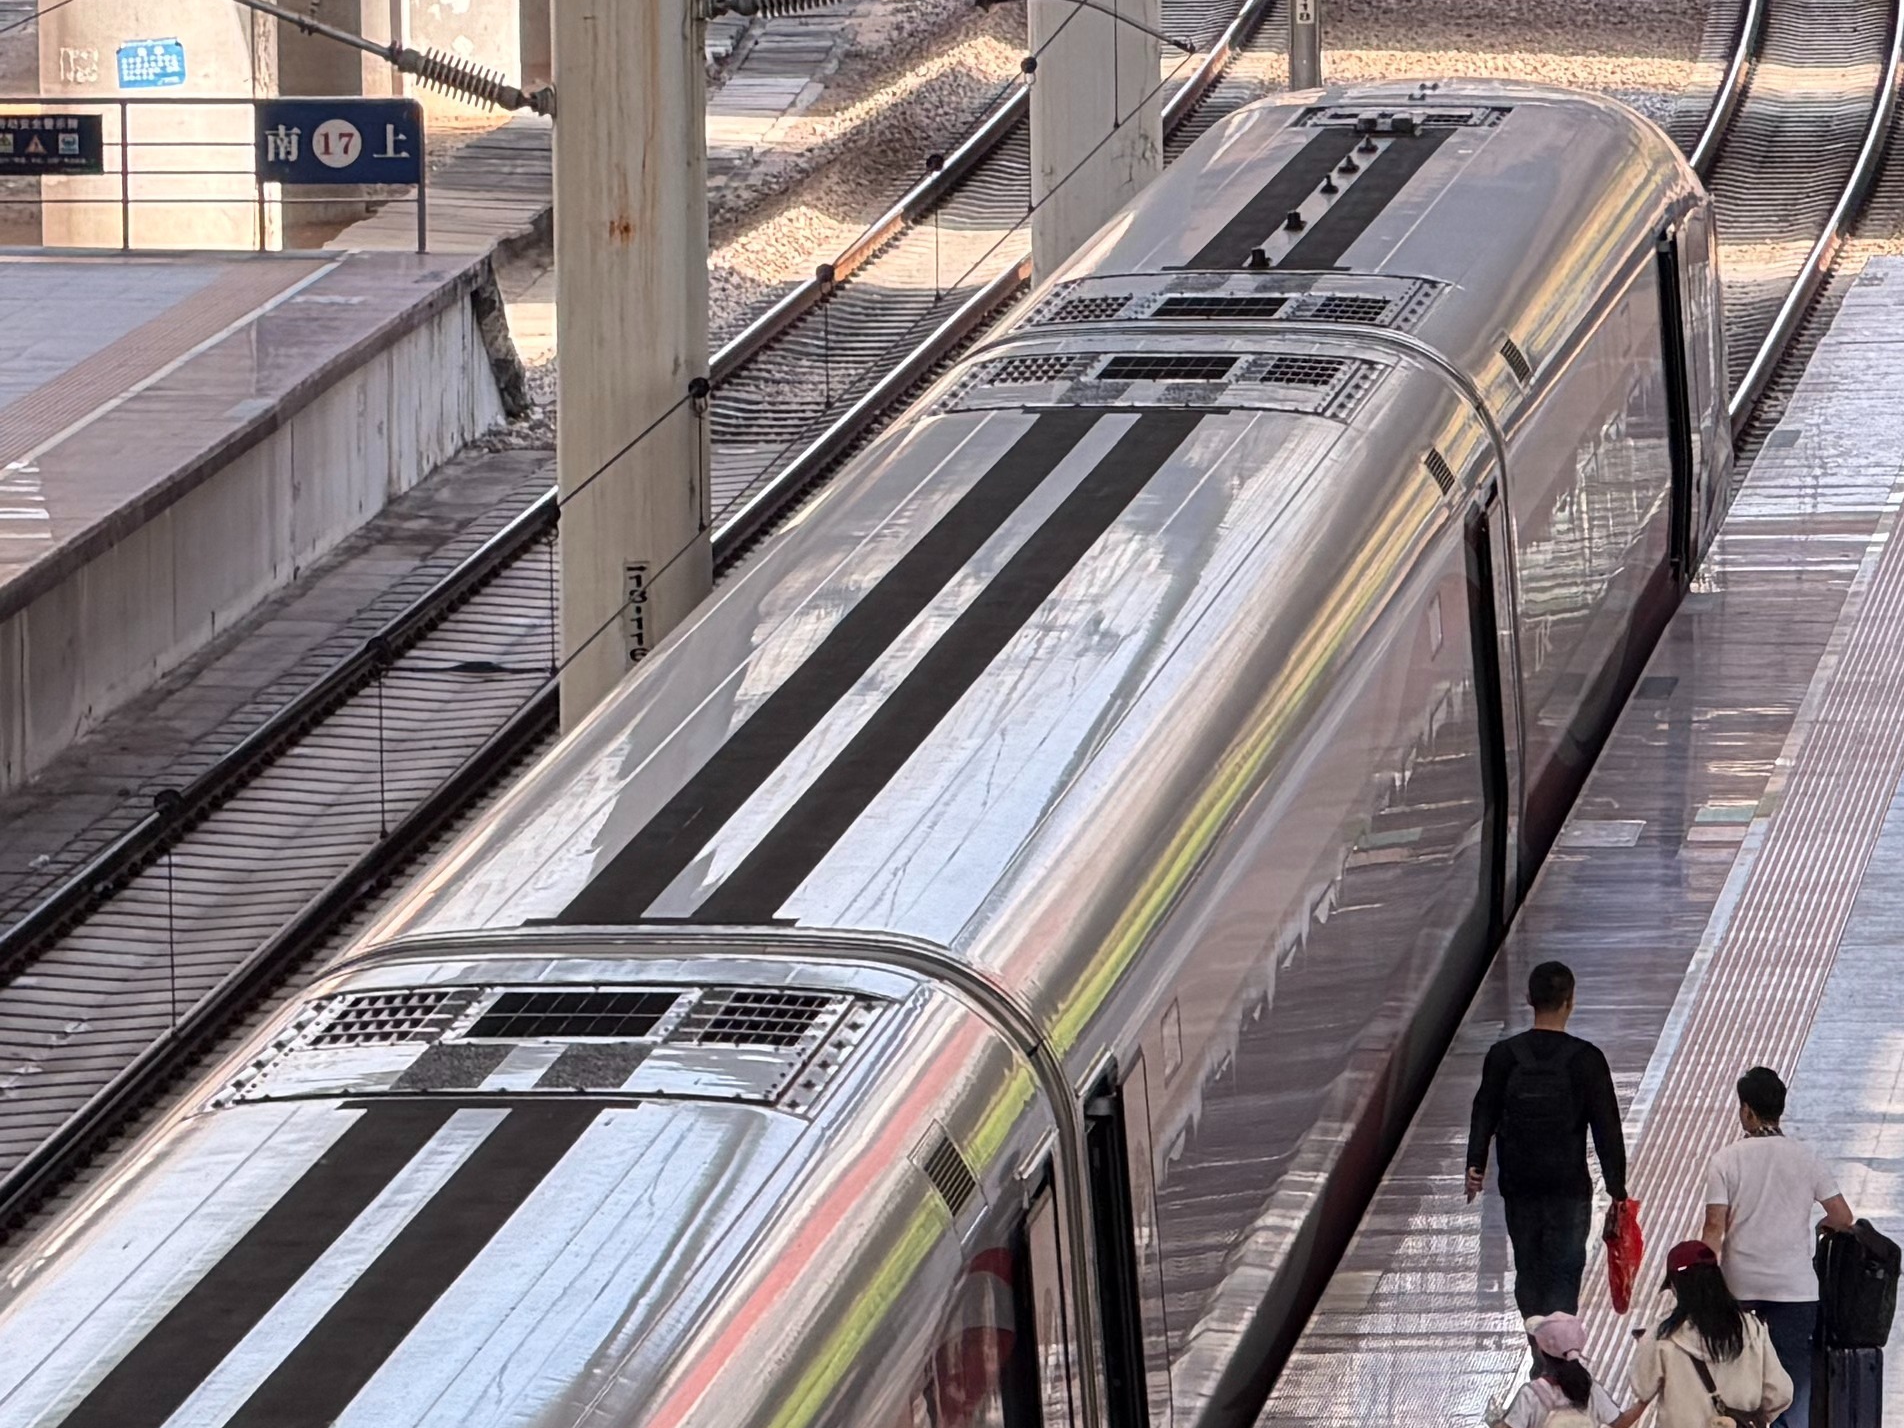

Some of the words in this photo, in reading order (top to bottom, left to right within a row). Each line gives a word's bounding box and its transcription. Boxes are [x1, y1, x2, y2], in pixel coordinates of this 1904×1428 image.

[264, 124, 302, 163] 南
[319, 131, 355, 156] 17
[372, 123, 411, 159] 上
